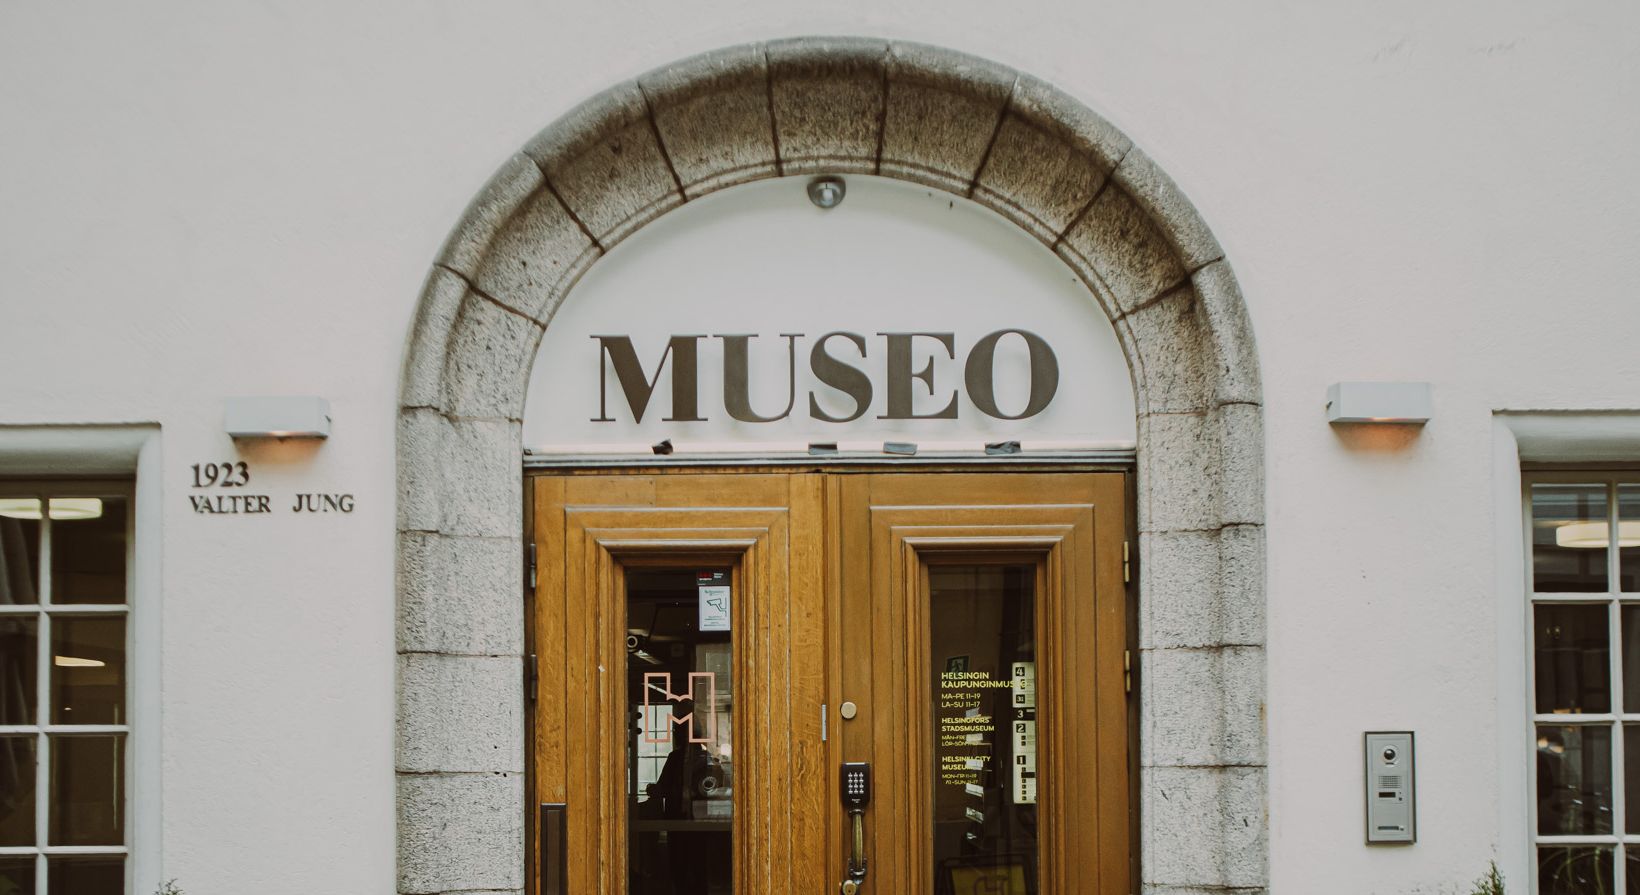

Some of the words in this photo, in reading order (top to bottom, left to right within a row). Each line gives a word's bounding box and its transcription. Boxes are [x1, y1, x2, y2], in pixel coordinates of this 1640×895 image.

[589, 327, 1060, 424] MUSEO
[191, 461, 250, 488] 1923
[189, 495, 272, 514] VALTER
[292, 494, 355, 513] JUNG
[941, 672, 990, 680] HELSINGIN
[941, 680, 1027, 689] KAUPUNGINMUSO
